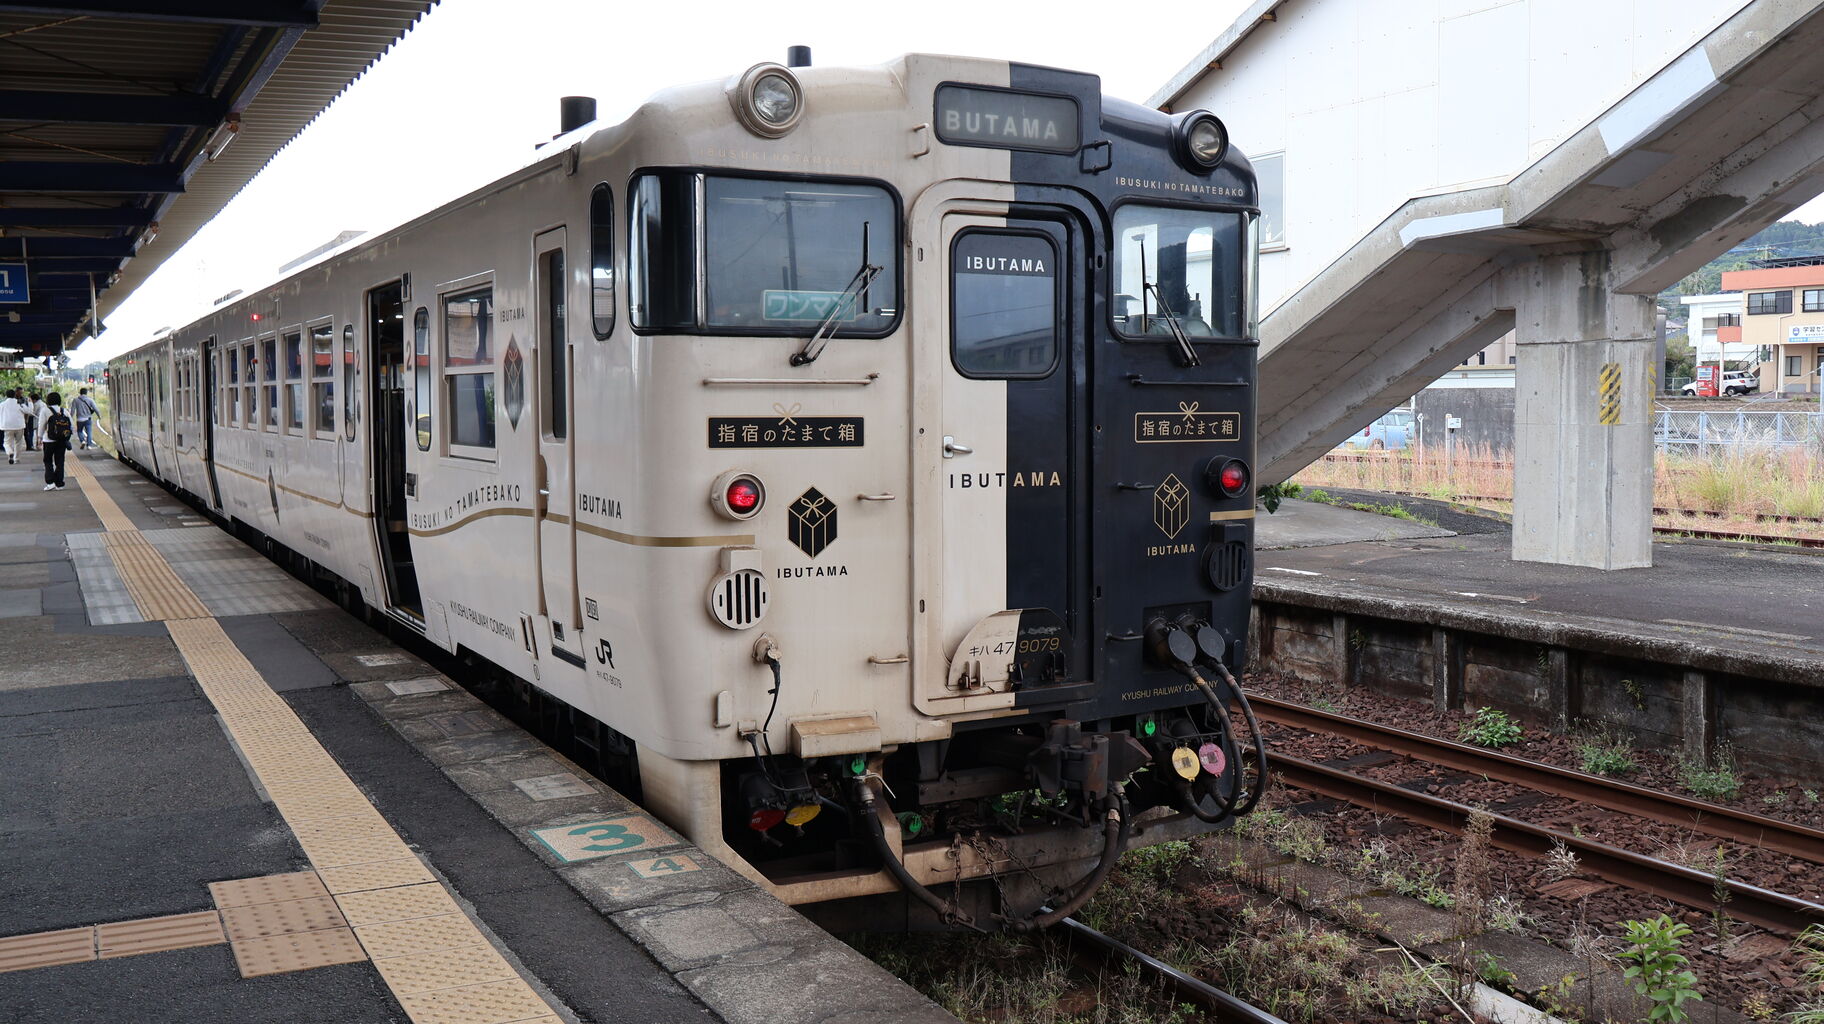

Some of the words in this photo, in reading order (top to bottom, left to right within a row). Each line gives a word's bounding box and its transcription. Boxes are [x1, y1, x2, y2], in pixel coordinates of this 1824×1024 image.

[945, 109, 1059, 140] BUTAMA
[1115, 176, 1161, 190] IBUSUKI
[1164, 182, 1177, 191] NO
[1179, 183, 1244, 197] TAMATEBAKO
[966, 255, 1045, 273] IBUTAMA
[500, 307, 525, 323] IBUTAMA
[717, 423, 856, 443] 指宿のたまて箱
[1142, 419, 1234, 437] 指宿のたまて箱
[949, 471, 1061, 489] IBUTAMA
[410, 511, 440, 529] IBUSUKI
[444, 506, 454, 521] NO
[457, 484, 521, 515] TAMATEBAKO
[579, 493, 622, 520] IBUTAMA
[1147, 543, 1196, 557] IBUTAMA
[777, 565, 848, 579] IBUTAMA
[595, 638, 615, 669] JR
[969, 645, 990, 657] キハ
[993, 641, 1015, 656] 47
[1018, 637, 1060, 654] 9079
[1121, 689, 1151, 701] KYUSHU
[1153, 684, 1183, 697] RAILWAY
[1184, 679, 1219, 692] COMNY
[567, 824, 646, 852] 3
[650, 858, 685, 872] 4
